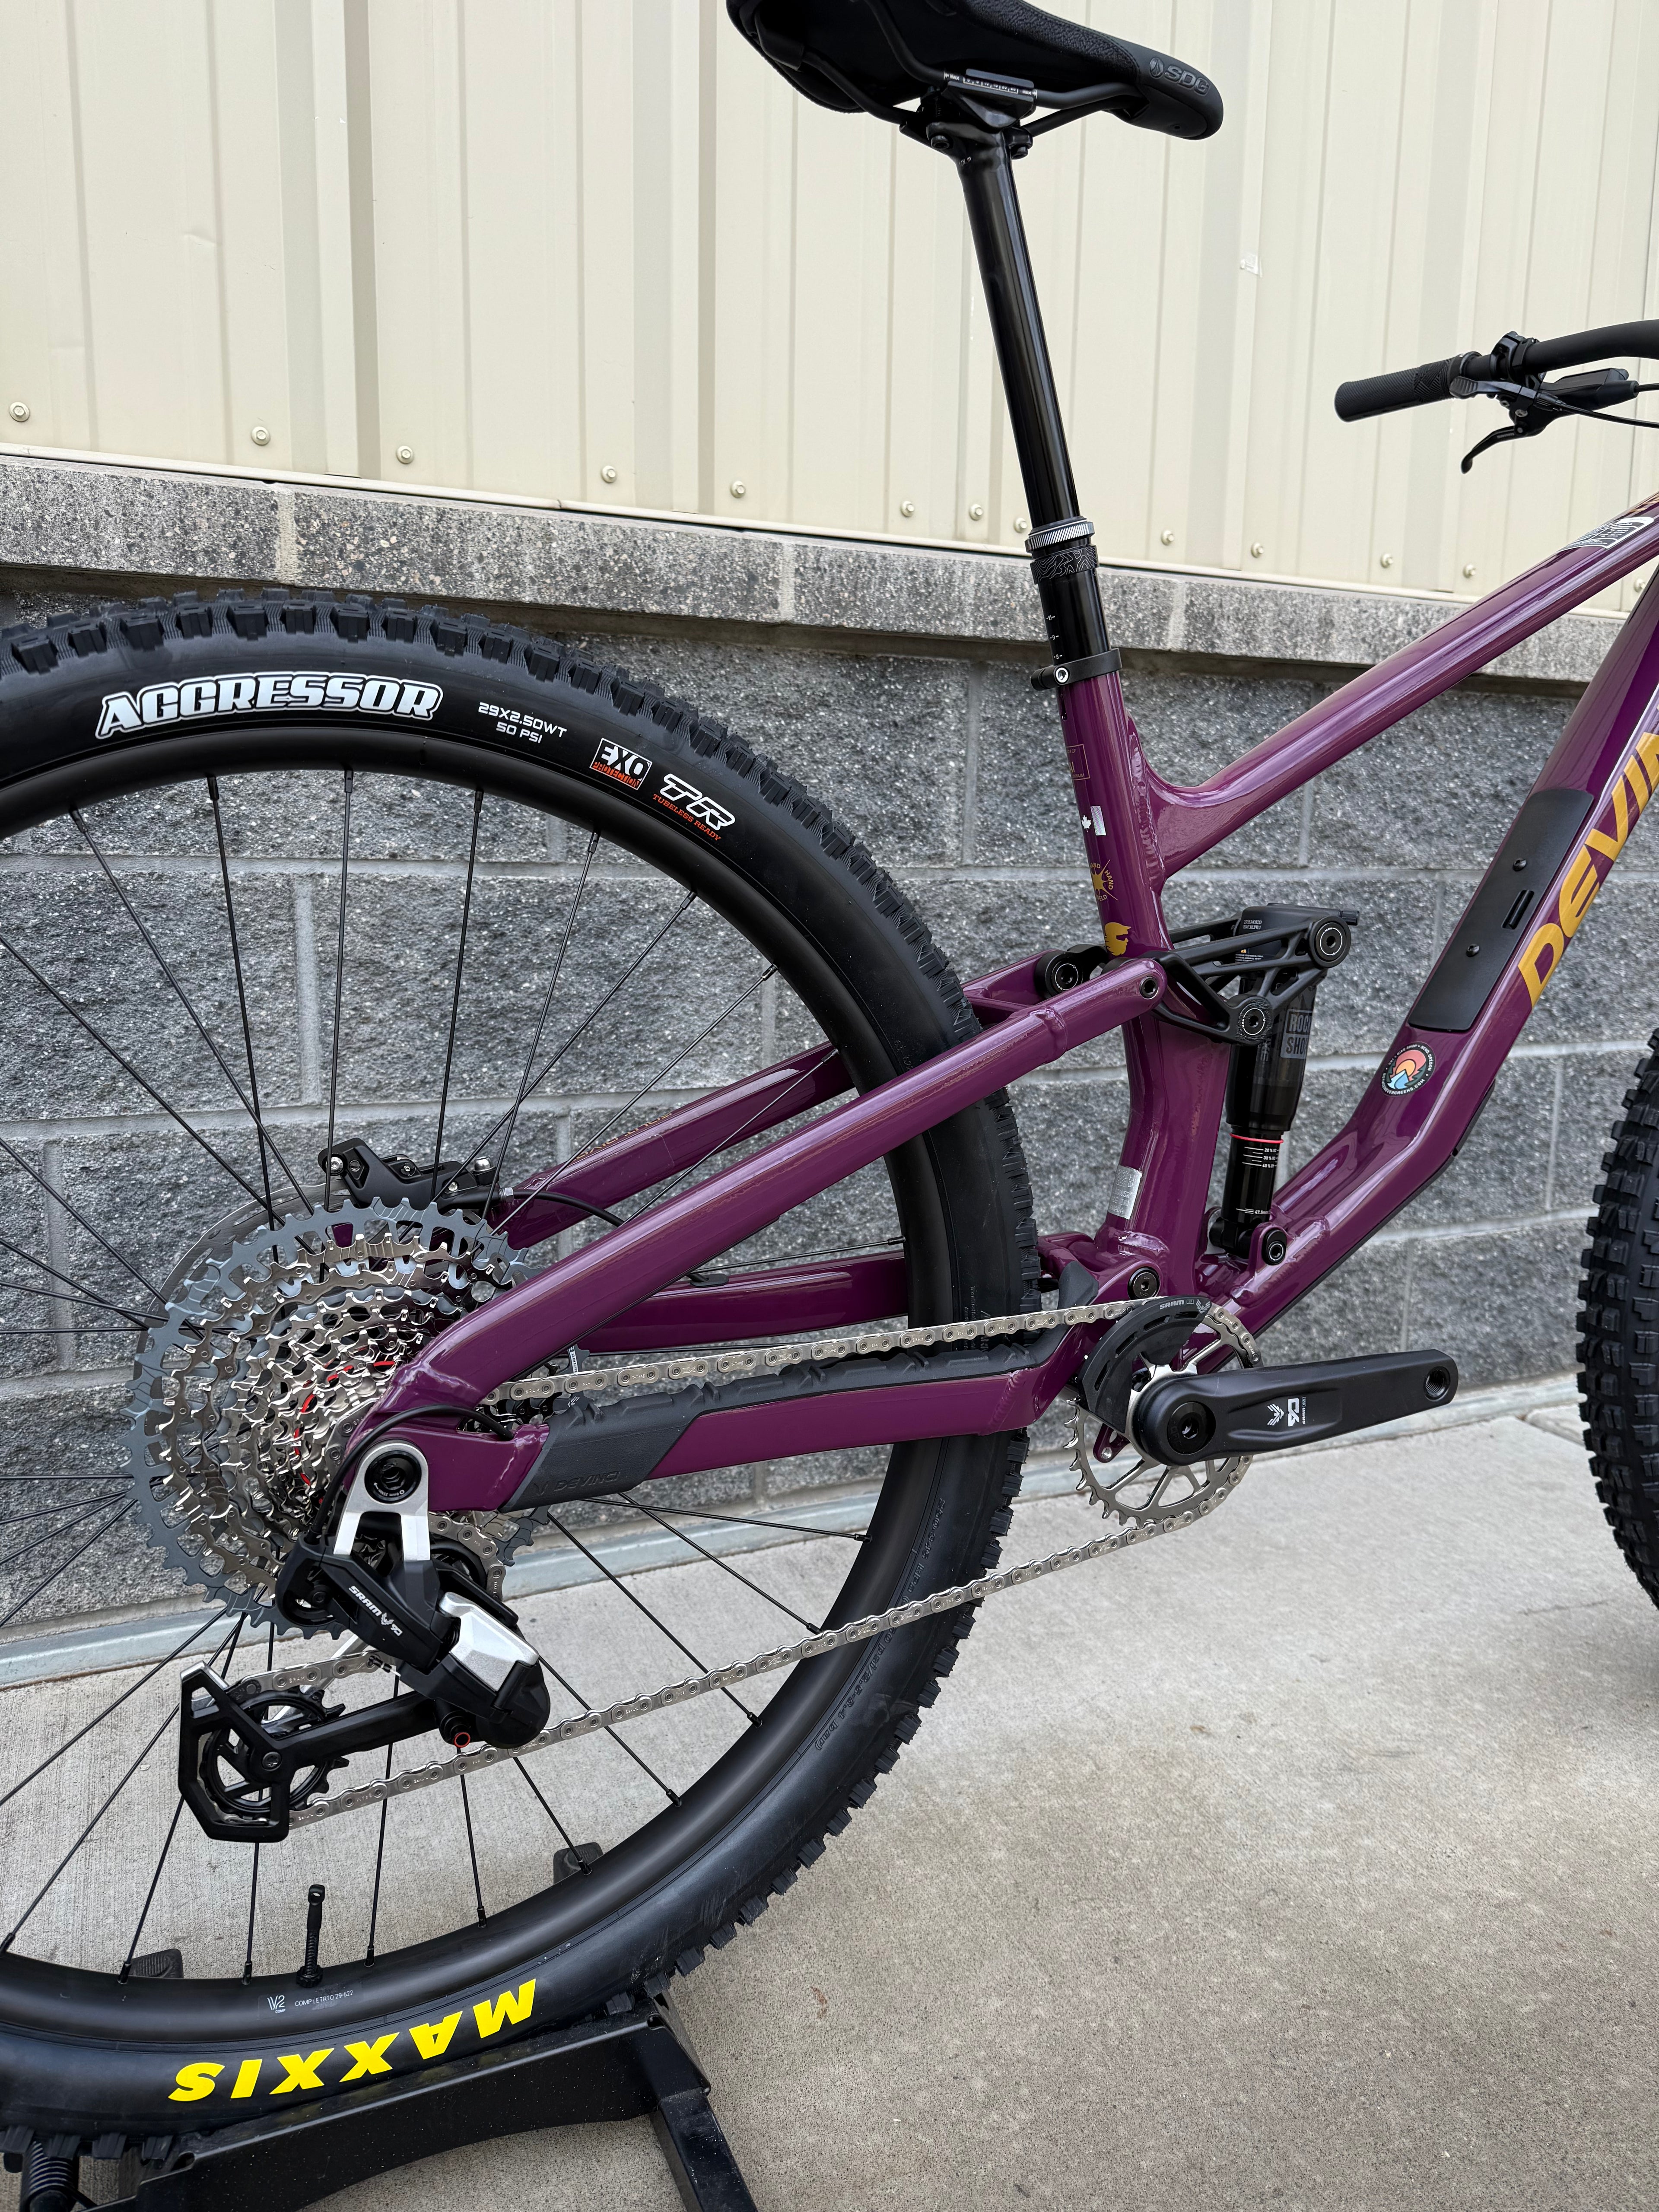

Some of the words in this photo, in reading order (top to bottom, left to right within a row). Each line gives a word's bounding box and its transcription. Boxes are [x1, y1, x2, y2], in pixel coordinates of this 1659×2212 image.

[1164, 65, 1210, 95] SDG
[95, 671, 443, 739] AGGRESSOR
[478, 702, 567, 738] 29X2.50WT
[496, 721, 516, 735] 50
[520, 728, 543, 744] PSI
[592, 761, 641, 790] PROTECTION
[600, 745, 651, 781] EXO
[659, 773, 735, 830] TR
[652, 793, 694, 822] TUBELESS
[693, 820, 721, 841] READY
[1104, 870, 1114, 890] HAND
[1160, 1300, 1184, 1309] SRAM
[553, 1470, 620, 1491] DEVINCI
[349, 1586, 382, 1616] SRAM
[316, 1995, 334, 2003] ETRTO
[168, 1979, 536, 2102] MAXXIS
